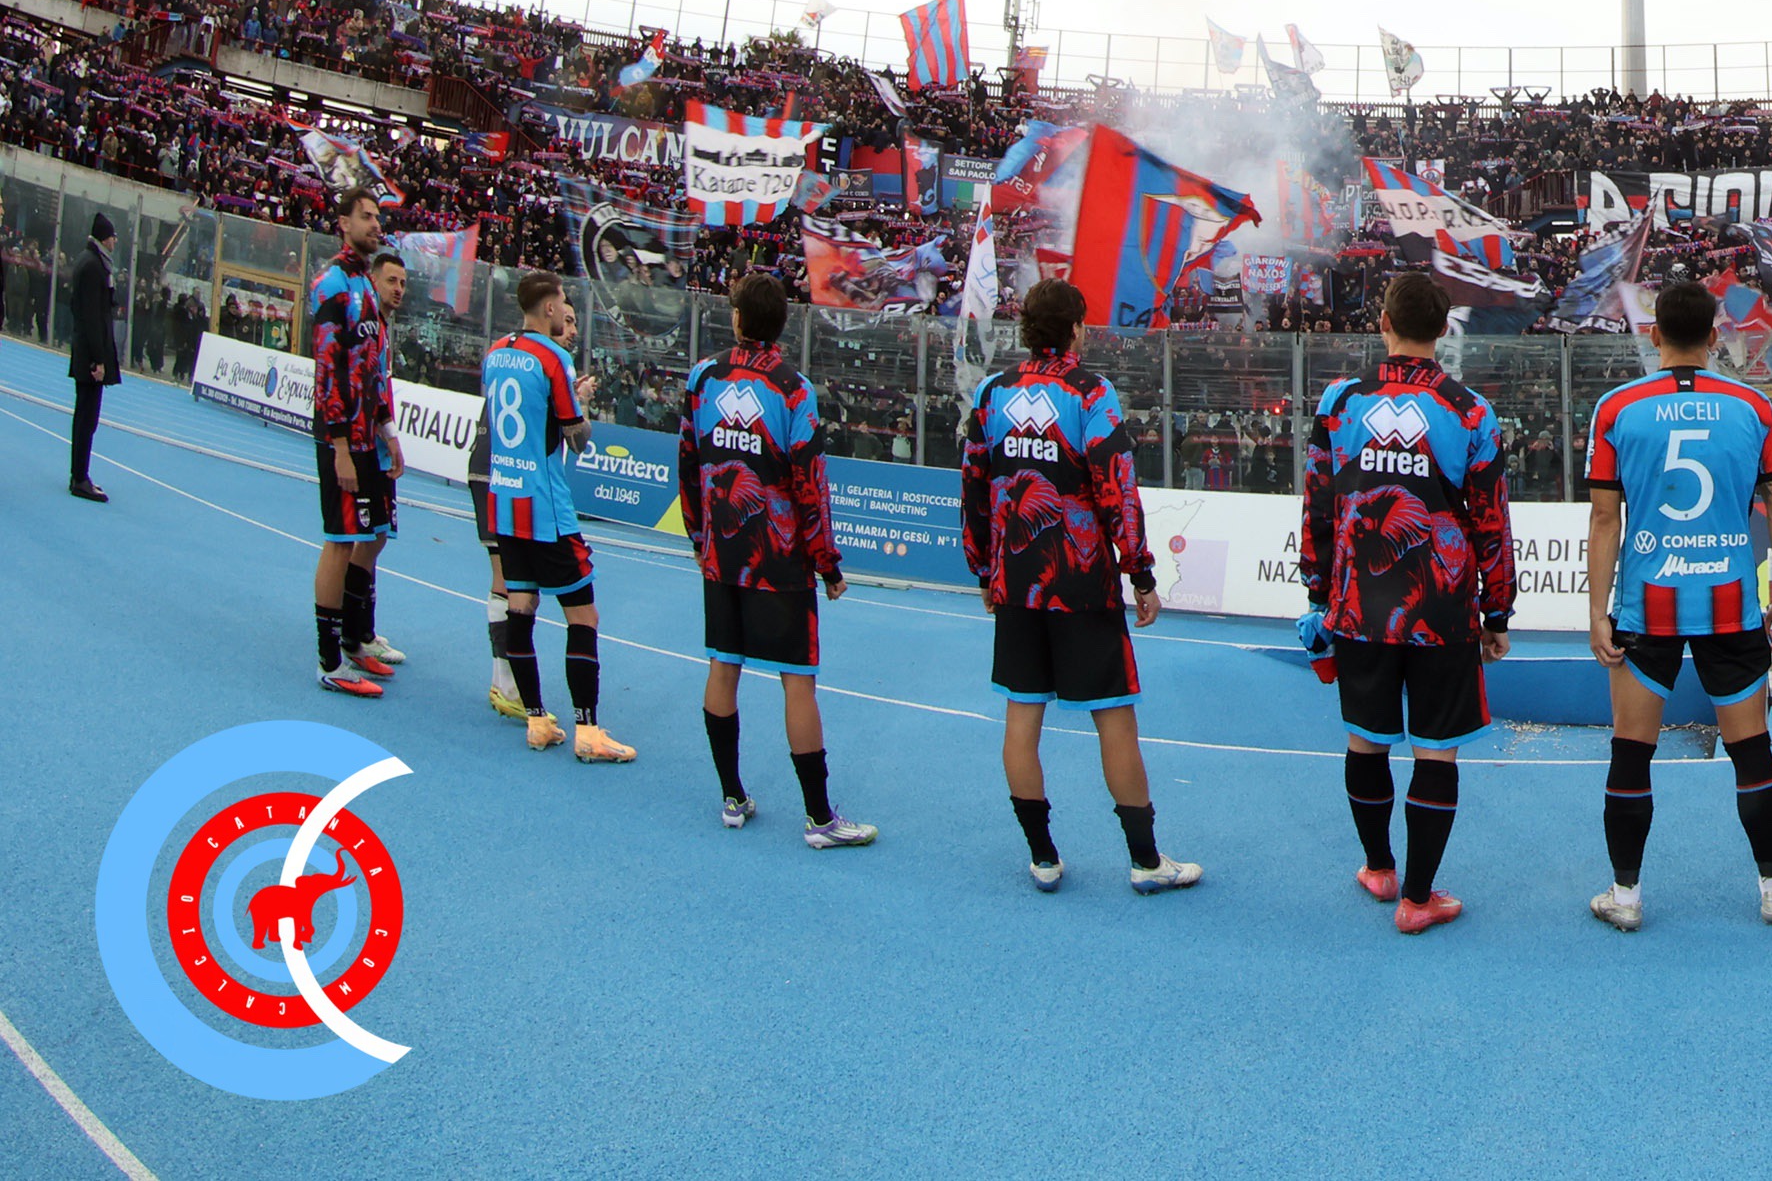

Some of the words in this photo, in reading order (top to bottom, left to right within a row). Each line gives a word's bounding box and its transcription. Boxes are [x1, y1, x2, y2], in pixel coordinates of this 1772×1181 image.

[949, 168, 967, 178] SAN
[967, 170, 997, 181] PAOLO
[955, 159, 993, 171] SETTORE
[761, 174, 794, 196] 729
[1244, 256, 1290, 268] GIARDINI
[1248, 269, 1286, 279] NAXOS
[487, 377, 527, 449] 18
[1656, 402, 1720, 422] MICELI
[712, 423, 763, 456] errea
[1003, 434, 1059, 463] errea
[515, 457, 537, 472] SUD
[575, 440, 670, 483] Privitera
[1360, 447, 1430, 478] errea
[1658, 429, 1715, 521] 5
[594, 484, 615, 500] dal
[614, 486, 641, 505] 1945
[846, 484, 893, 500] GELATERIA
[869, 500, 928, 517] BANQUETING
[834, 534, 878, 551] CATANIA
[855, 523, 888, 538] MARIA
[889, 528, 901, 540] DI
[951, 537, 958, 548] 1
[1661, 534, 1717, 549] COMER
[1719, 533, 1748, 547] SUD
[1548, 539, 1570, 562] DI
[1654, 553, 1730, 580] Muracel
[1172, 592, 1218, 608] CATANIA
